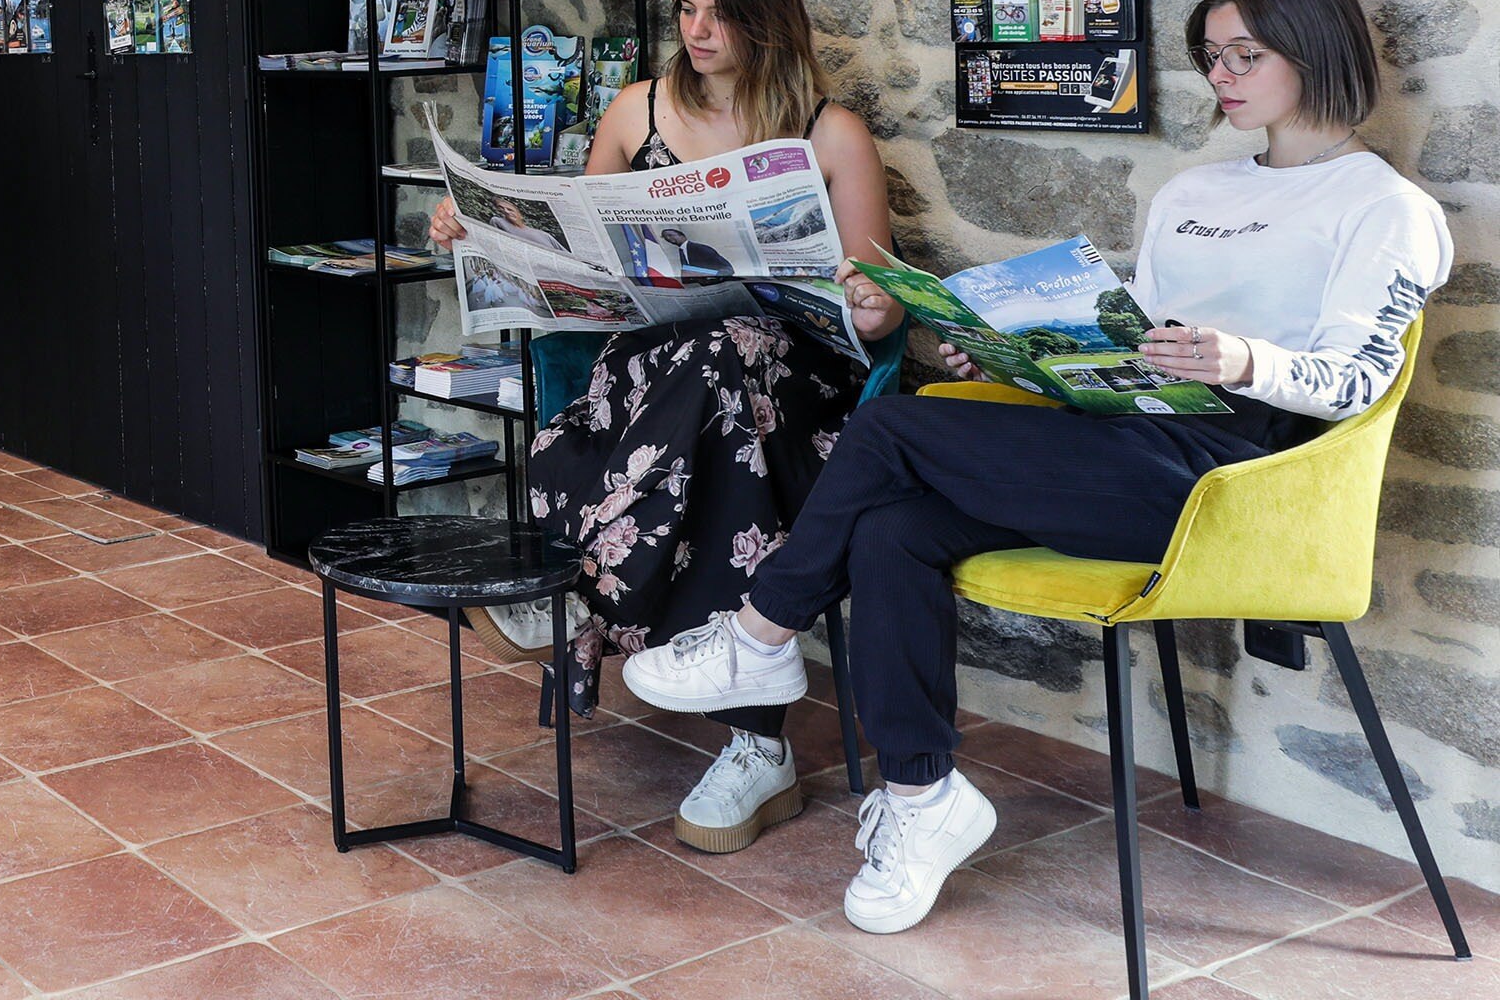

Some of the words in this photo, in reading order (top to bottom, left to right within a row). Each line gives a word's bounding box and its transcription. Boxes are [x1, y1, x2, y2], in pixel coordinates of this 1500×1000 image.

[991, 62, 1025, 70] Retrouvez
[1025, 62, 1041, 70] tous
[1041, 62, 1053, 70] les
[1053, 62, 1071, 70] bons
[1071, 62, 1092, 71] plans
[991, 70, 1036, 81] VISITES
[1039, 70, 1092, 81] PASSION
[652, 169, 704, 189] ouest
[489, 183, 516, 192] devenu
[516, 189, 564, 197] philanthrope
[647, 181, 706, 199] france
[612, 207, 675, 217] portefeuille
[676, 206, 691, 214] de
[692, 204, 703, 213] la
[704, 202, 727, 211] mer
[615, 214, 653, 223] Breton
[654, 213, 688, 222] Hervé
[689, 211, 732, 222] Berville
[1176, 219, 1220, 238] Trust
[1219, 229, 1237, 239] no
[1023, 286, 1036, 296] de
[1036, 271, 1091, 293] Bretagne
